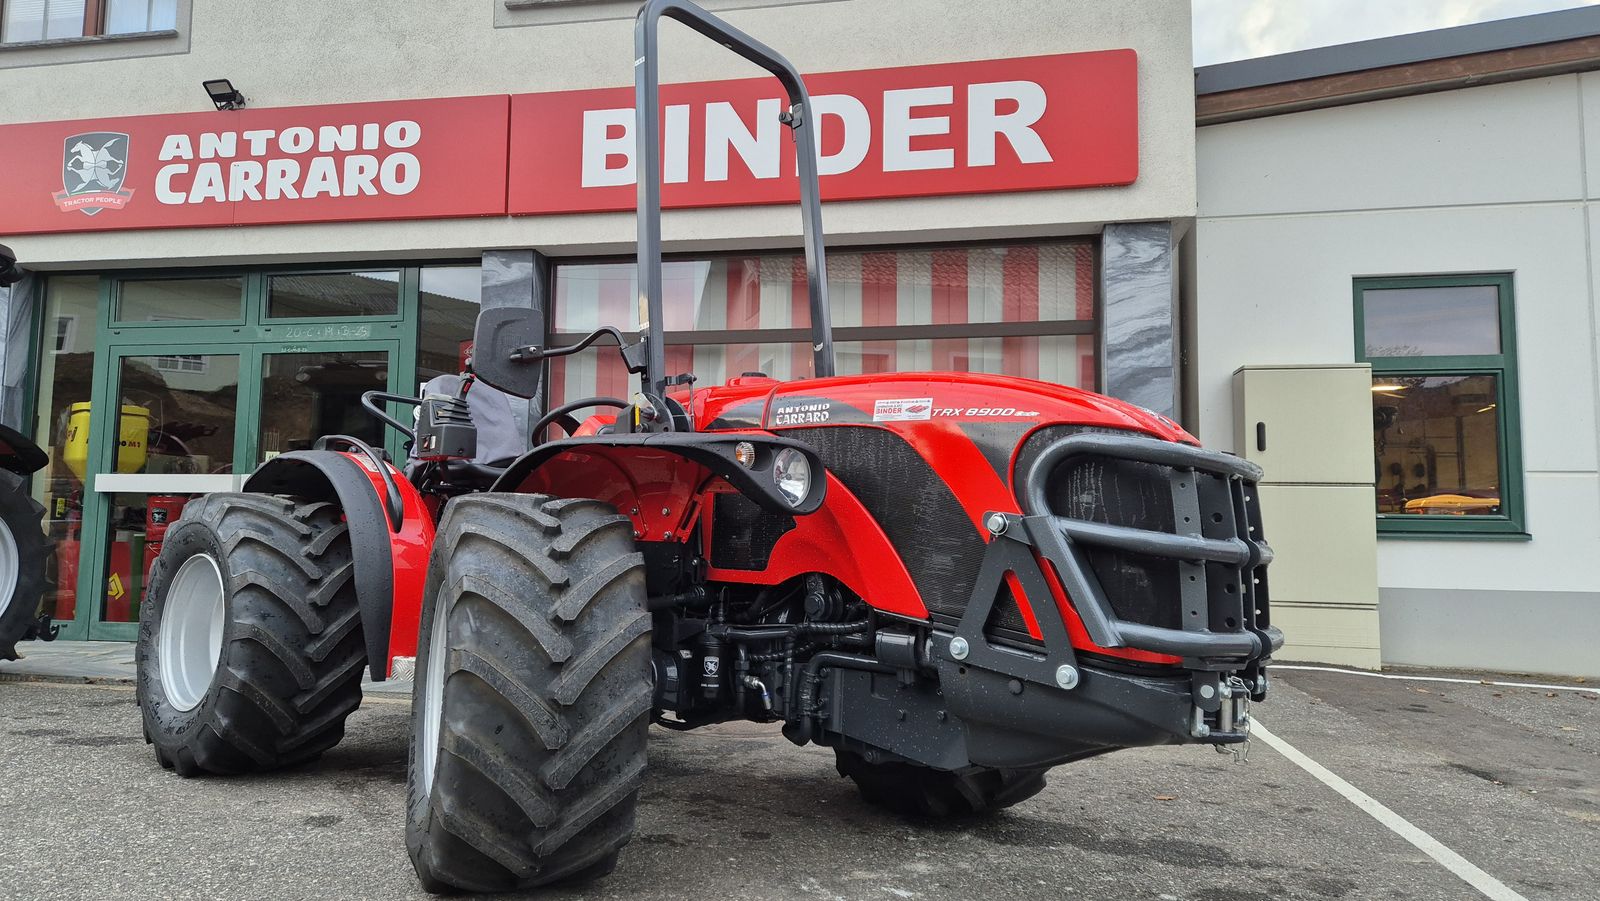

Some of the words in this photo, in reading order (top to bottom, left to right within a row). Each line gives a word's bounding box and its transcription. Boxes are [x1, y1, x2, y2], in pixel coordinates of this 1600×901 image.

[158, 120, 421, 161] ANTONIO
[581, 80, 1053, 188] BINDER
[155, 151, 421, 204] CARRARO
[63, 197, 94, 207] TRACTOR
[95, 196, 121, 205] PEOPLE
[777, 402, 830, 414] ANTONIO
[932, 408, 964, 417] TRX
[965, 407, 1016, 417] 8900
[775, 411, 830, 425] CARRARO
